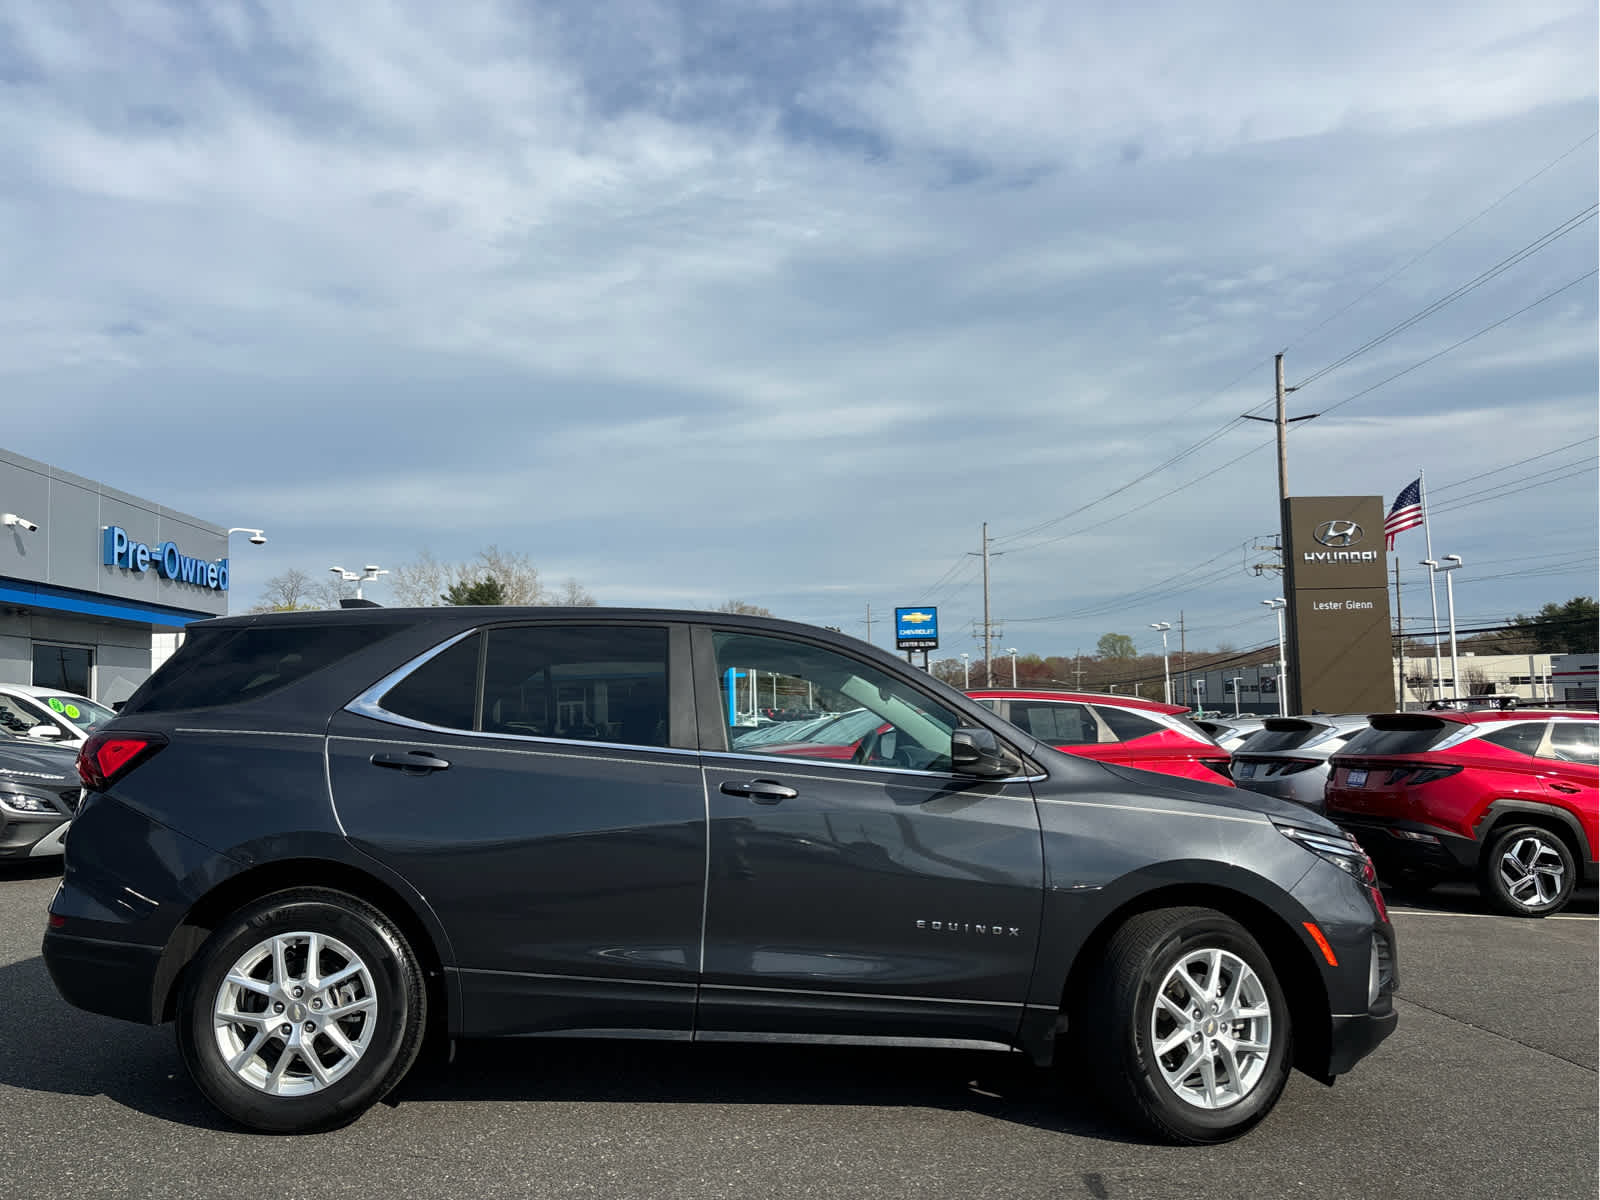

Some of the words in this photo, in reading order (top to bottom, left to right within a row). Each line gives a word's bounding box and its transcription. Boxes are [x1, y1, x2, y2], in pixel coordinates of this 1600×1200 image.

[104, 526, 230, 591] Pre-Owned
[1303, 550, 1377, 564] HYUNDAI
[1313, 600, 1343, 610] Lester
[1345, 600, 1373, 609] Glenn
[899, 628, 935, 636] CHEVROLET
[915, 919, 1020, 936] EQUINOX
